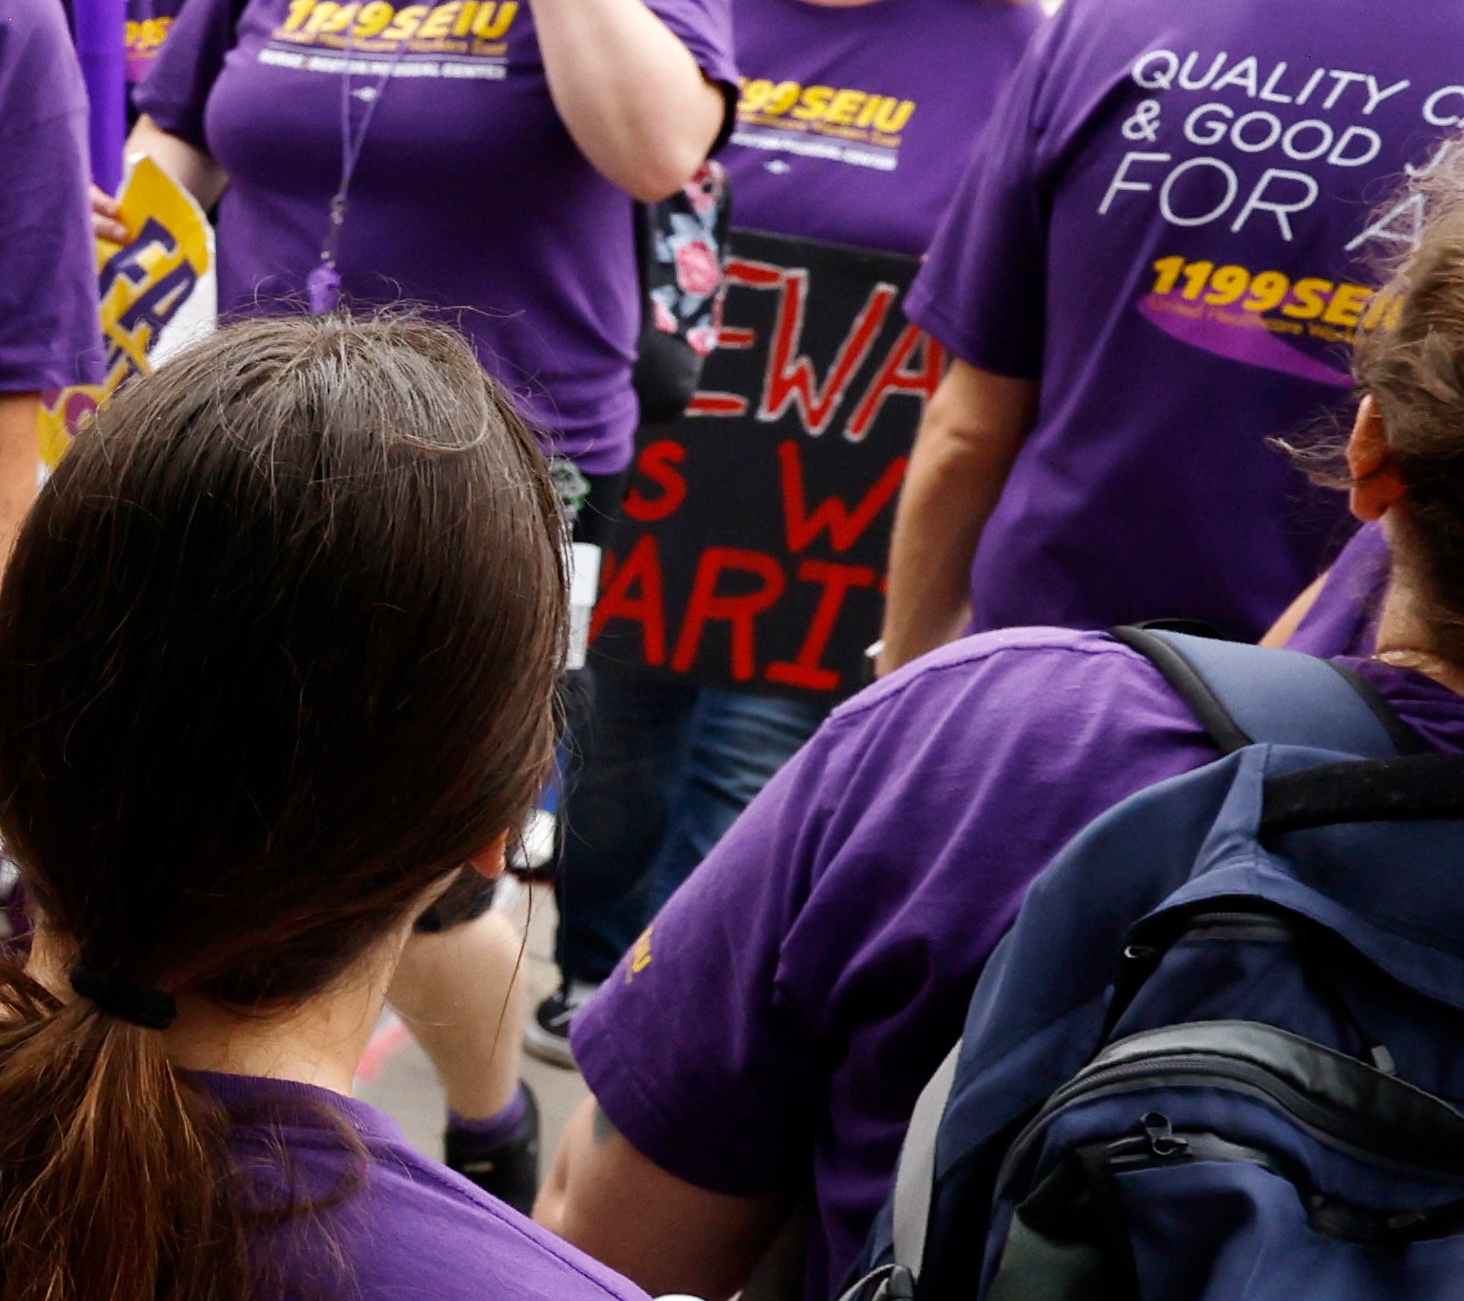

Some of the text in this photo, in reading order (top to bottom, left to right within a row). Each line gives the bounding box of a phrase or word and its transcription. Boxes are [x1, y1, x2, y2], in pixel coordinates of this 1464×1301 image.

[736, 75, 917, 134] 99SEIU
[1130, 48, 1412, 116] QUALITY
[1121, 99, 1161, 143] &
[1183, 102, 1382, 168] GOOD
[1096, 151, 1320, 243] FOR
